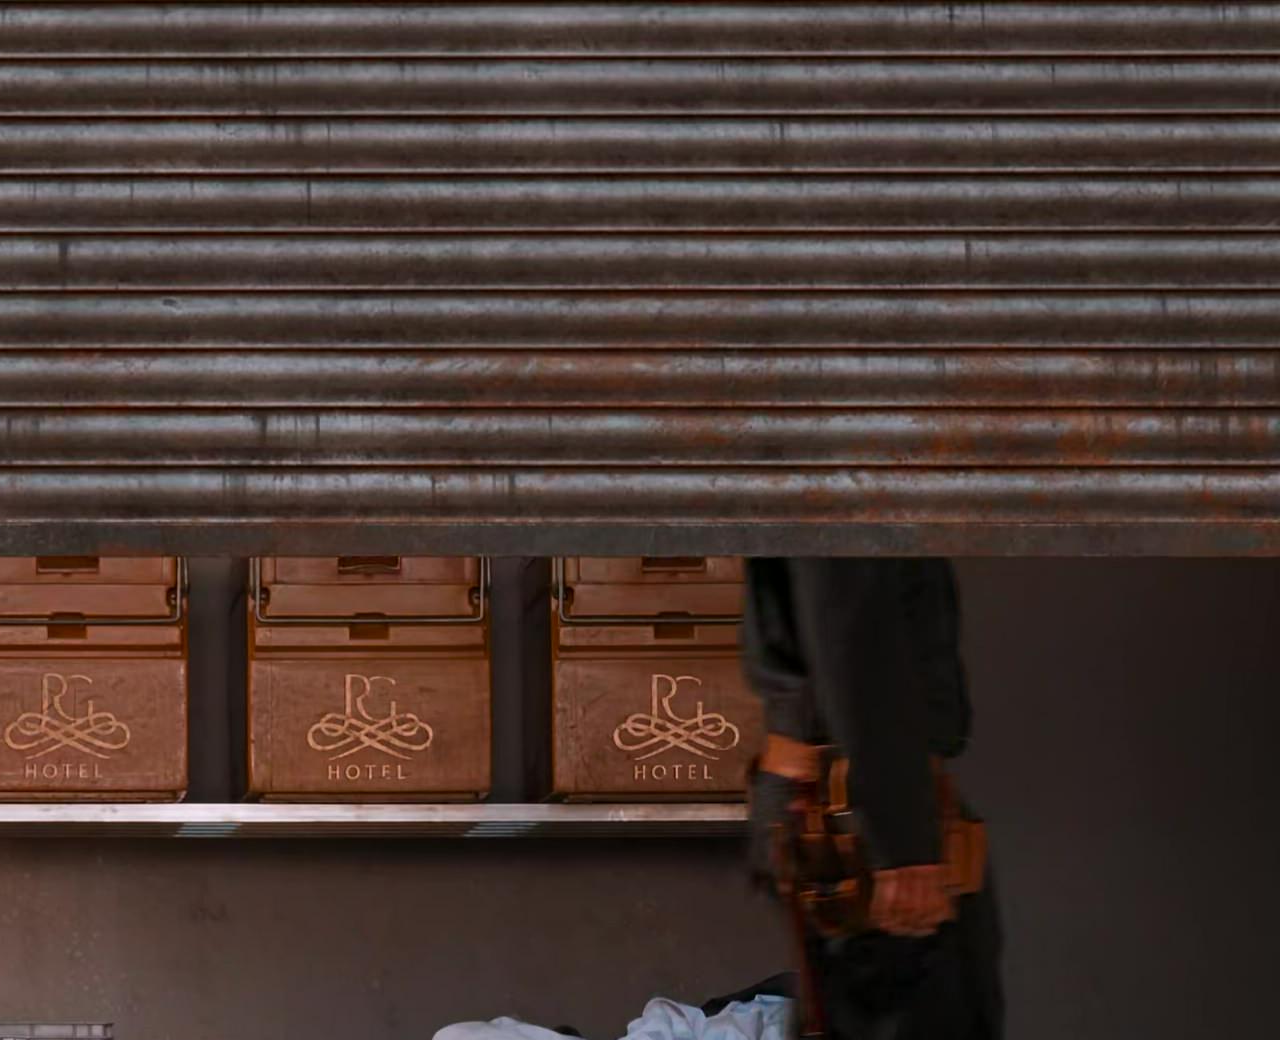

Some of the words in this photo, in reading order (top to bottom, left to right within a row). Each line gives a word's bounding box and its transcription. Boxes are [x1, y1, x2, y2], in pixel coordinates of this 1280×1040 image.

[25, 763, 103, 779] HOTEL
[328, 764, 407, 780] HOTEL
[634, 764, 713, 780] HOTEL
